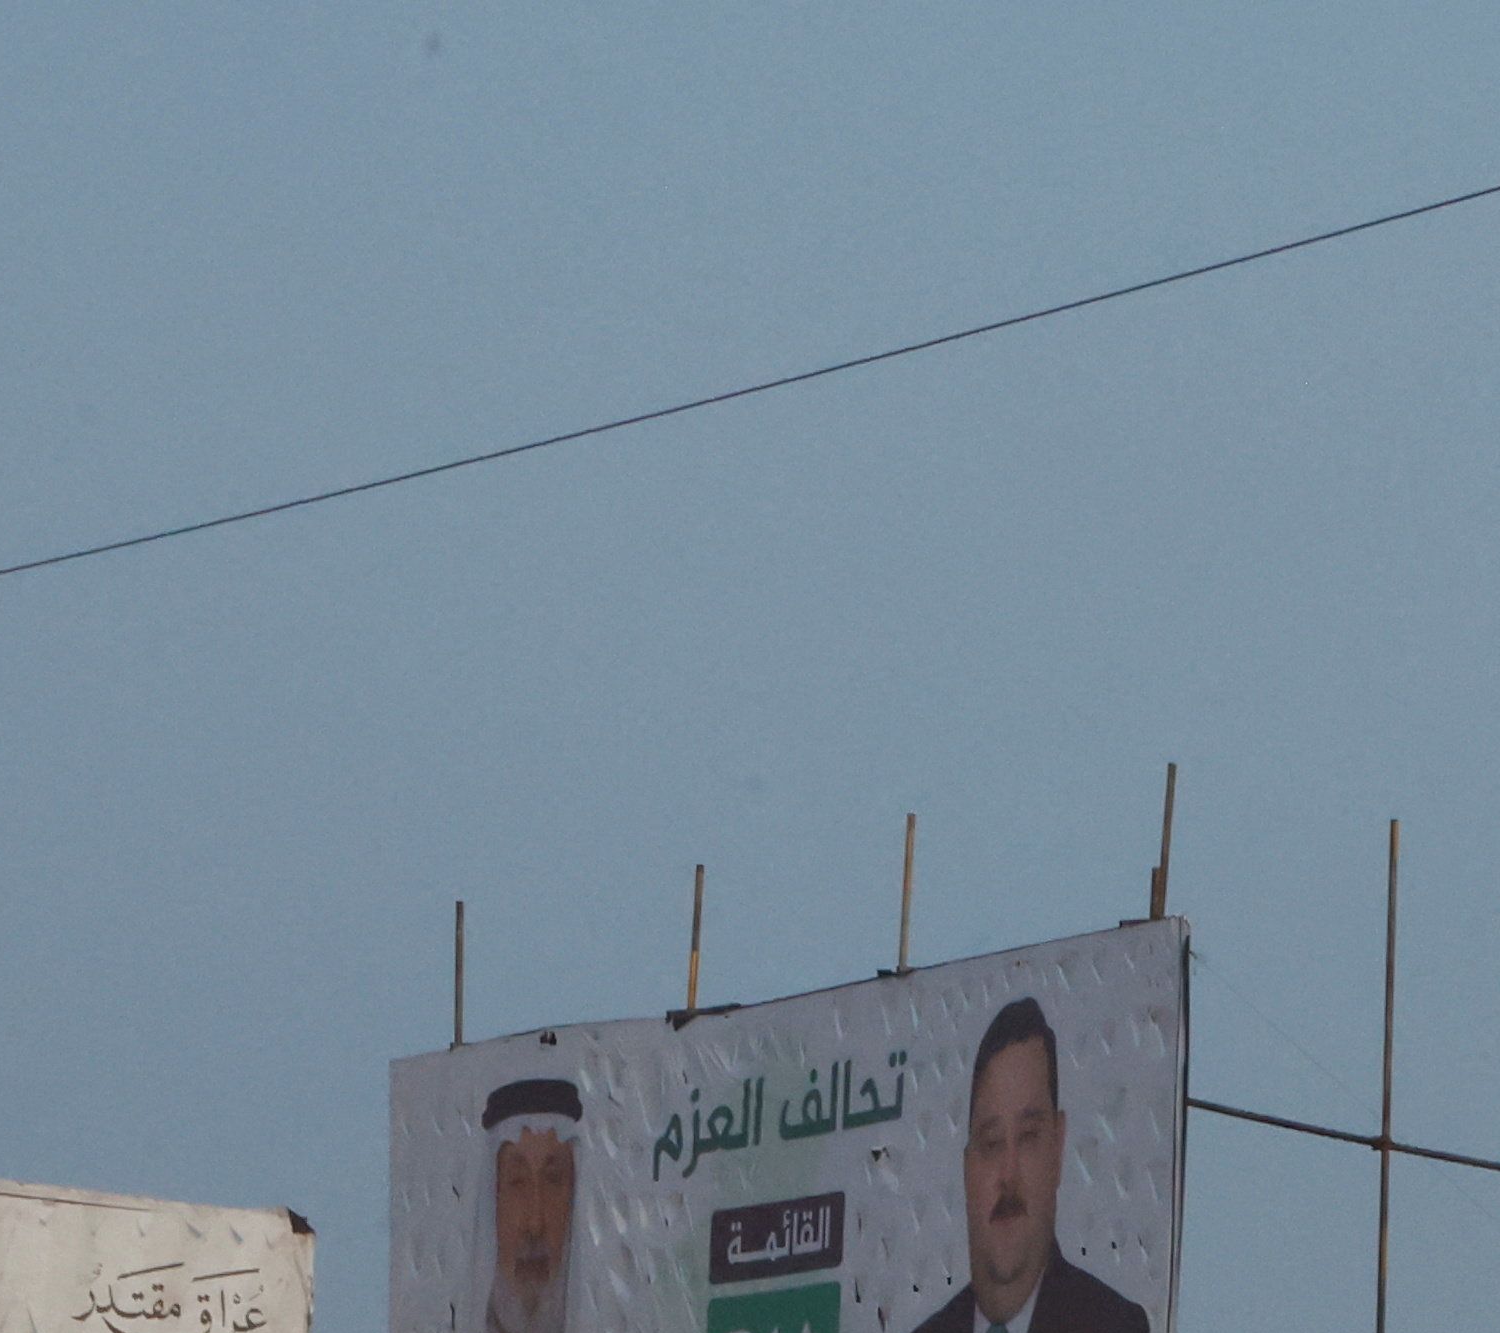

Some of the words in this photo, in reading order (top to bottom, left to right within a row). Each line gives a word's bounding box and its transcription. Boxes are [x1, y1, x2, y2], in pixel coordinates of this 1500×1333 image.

[653, 1076, 765, 1182] العزم
[779, 1050, 907, 1141] تحالف
[726, 1205, 832, 1265] القائمة
